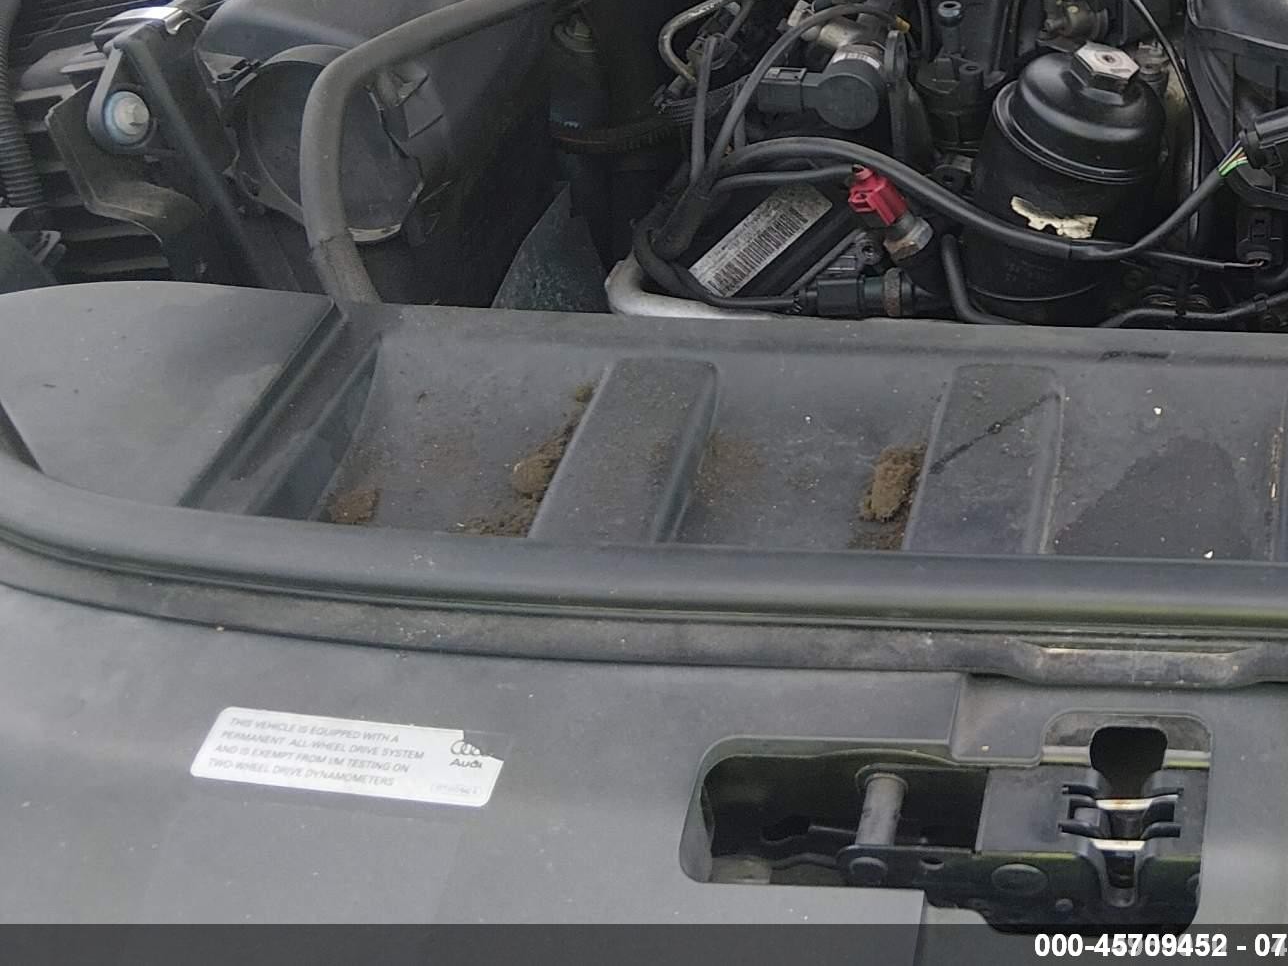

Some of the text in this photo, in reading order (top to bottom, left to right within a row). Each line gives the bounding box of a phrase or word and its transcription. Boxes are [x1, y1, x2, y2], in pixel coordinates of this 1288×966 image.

[230, 717, 399, 743] THIS VEHICLE IS EQUIPPED WITH A
[221, 729, 286, 744] PERMANENT
[348, 744, 379, 756] DRIVE
[381, 747, 424, 759] SYSTEM
[215, 744, 239, 754] AND
[239, 745, 250, 755] IS
[251, 747, 294, 760] EXEMPT
[295, 752, 327, 764] FROM
[347, 758, 391, 771] TESTING
[392, 763, 410, 773] ON
[449, 758, 483, 769] Audi
[272, 765, 304, 778] DRIVE
[305, 768, 396, 786] DYNAMOMETERS
